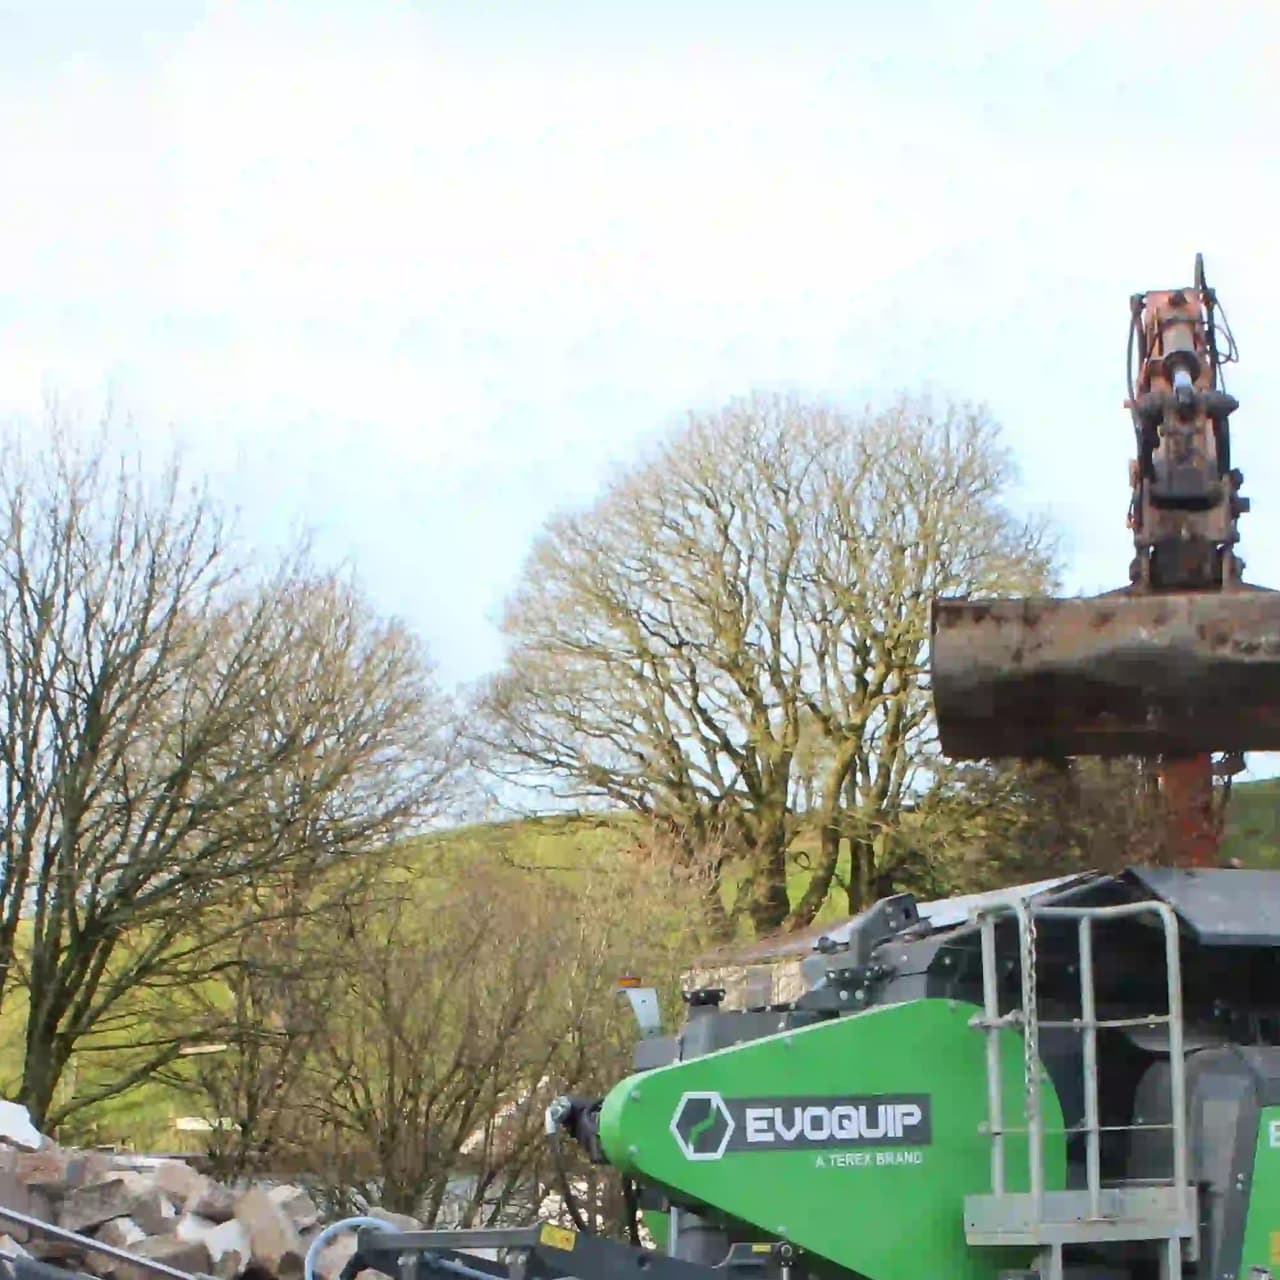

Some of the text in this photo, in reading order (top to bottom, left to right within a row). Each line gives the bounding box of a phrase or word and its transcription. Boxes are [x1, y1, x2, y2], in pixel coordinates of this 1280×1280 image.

[745, 1104, 922, 1142] EVOQUIP
[815, 1151, 922, 1168] A TEREX BRAND
